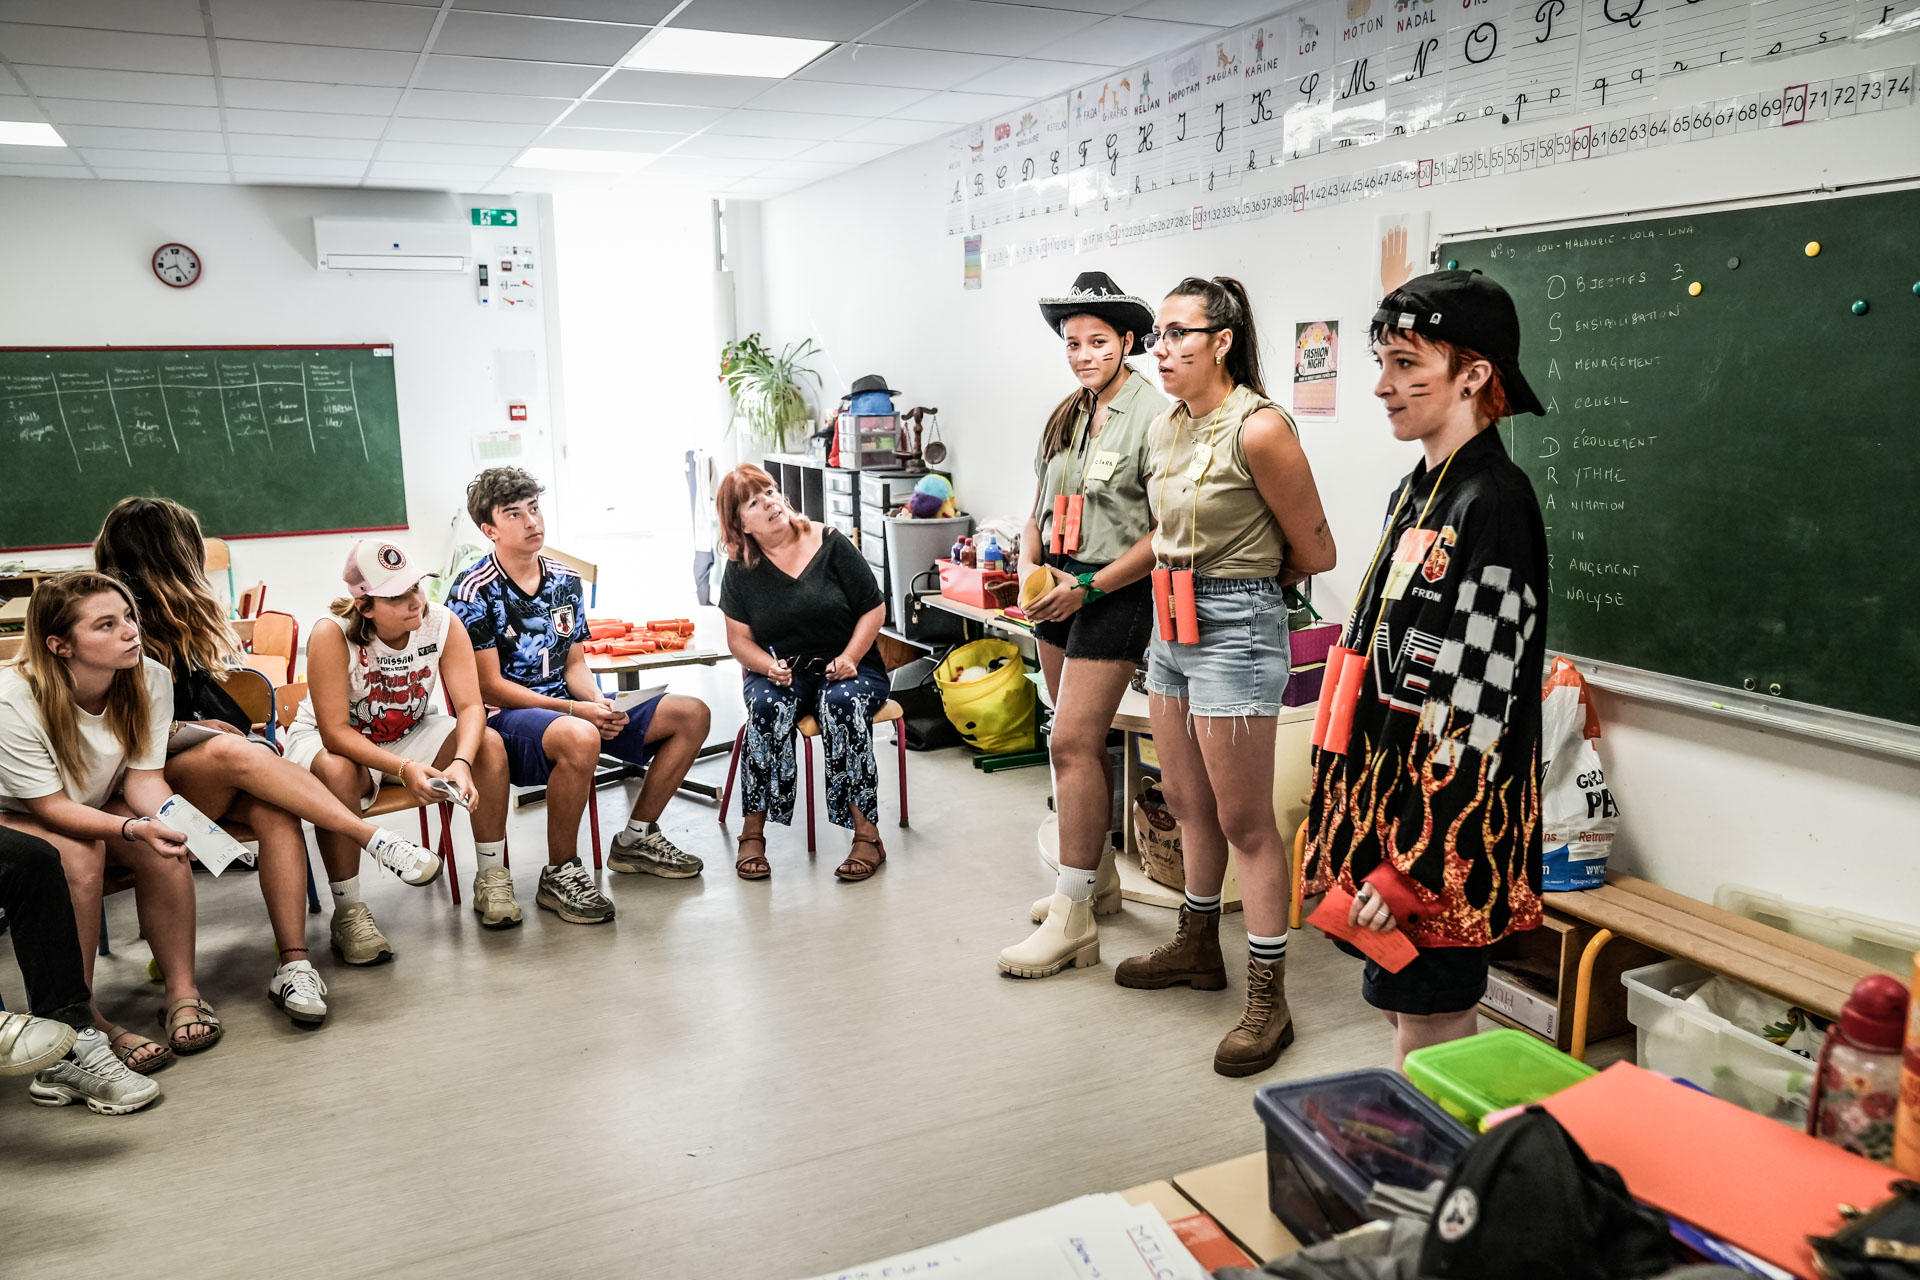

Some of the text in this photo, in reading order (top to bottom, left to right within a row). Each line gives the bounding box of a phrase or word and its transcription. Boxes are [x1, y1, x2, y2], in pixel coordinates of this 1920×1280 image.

[1344, 16, 1384, 41] MOTON
[1397, 10, 1436, 33] NADAL
[1298, 41, 1317, 55] LOP
[1464, 22, 1497, 63] O
[1405, 38, 1438, 82] N
[1206, 65, 1239, 84] JAGUAR
[1342, 58, 1376, 98] M
[1250, 89, 1272, 124] K
[1150, 222, 1158, 232] 25
[1158, 220, 1166, 230] 26
[1166, 218, 1174, 229] 27
[1175, 216, 1184, 228] 28
[1203, 210, 1211, 222] 31
[1212, 208, 1220, 220] 32
[1222, 207, 1230, 218] 33
[1232, 205, 1240, 216] 34
[1251, 201, 1260, 212] 36
[1262, 198, 1271, 210] 37
[1272, 196, 1282, 208] 38
[1283, 194, 1293, 206] 39
[1305, 189, 1314, 200] 41
[1316, 186, 1326, 198] 42
[1328, 184, 1338, 196] 43
[1352, 179, 1362, 192] 45
[1364, 176, 1376, 188] 46
[1378, 173, 1389, 186] 47
[1391, 170, 1402, 182] 48
[1434, 162, 1444, 176] 51
[1448, 158, 1458, 174] 52
[1462, 156, 1474, 172] 53
[1492, 151, 1504, 168] 55
[1507, 147, 1520, 164] 56
[1522, 142, 1536, 161] 57
[1540, 138, 1554, 158] 58
[1556, 136, 1572, 154] 59
[1574, 134, 1589, 152] 60
[1592, 130, 1606, 148] 61
[1610, 127, 1627, 144] 62
[1629, 124, 1647, 140] 63
[1650, 118, 1667, 138] 64
[1673, 115, 1690, 133] 65
[1693, 112, 1712, 130] 66
[1715, 107, 1735, 126] 67
[1738, 103, 1758, 122] 68
[1760, 98, 1782, 118] 69
[1786, 95, 1804, 114] 70
[1808, 90, 1828, 110] 71
[1834, 86, 1856, 106] 72
[1860, 81, 1882, 101] 73
[1888, 76, 1910, 97] 74
[1538, 244, 1554, 252] LOU
[1630, 231, 1654, 241] LOLA
[1304, 346, 1330, 360] FASHION
[1307, 358, 1326, 369] NIGHT
[1572, 530, 1584, 540] IN
